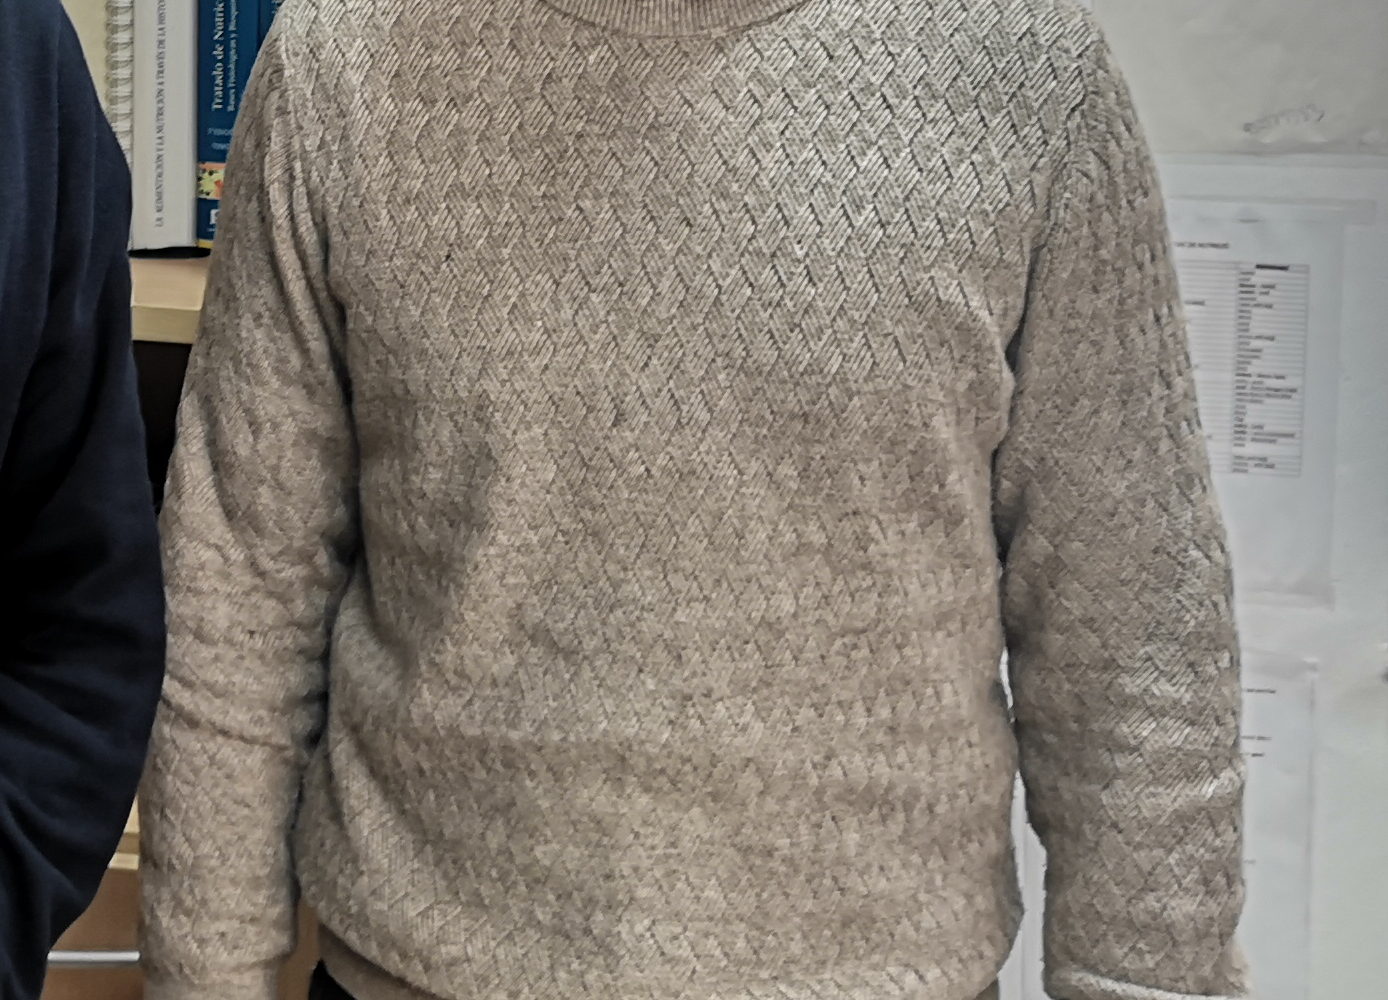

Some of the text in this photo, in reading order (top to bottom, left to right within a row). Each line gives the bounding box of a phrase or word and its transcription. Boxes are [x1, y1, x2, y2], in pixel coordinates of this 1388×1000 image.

[156, 50, 165, 78] TRAVÉS
[212, 43, 224, 59] de
[209, 62, 224, 110] Tratado
[155, 88, 164, 133] NUTRICIÓN
[155, 153, 164, 212] ALIMENTACIÓN
